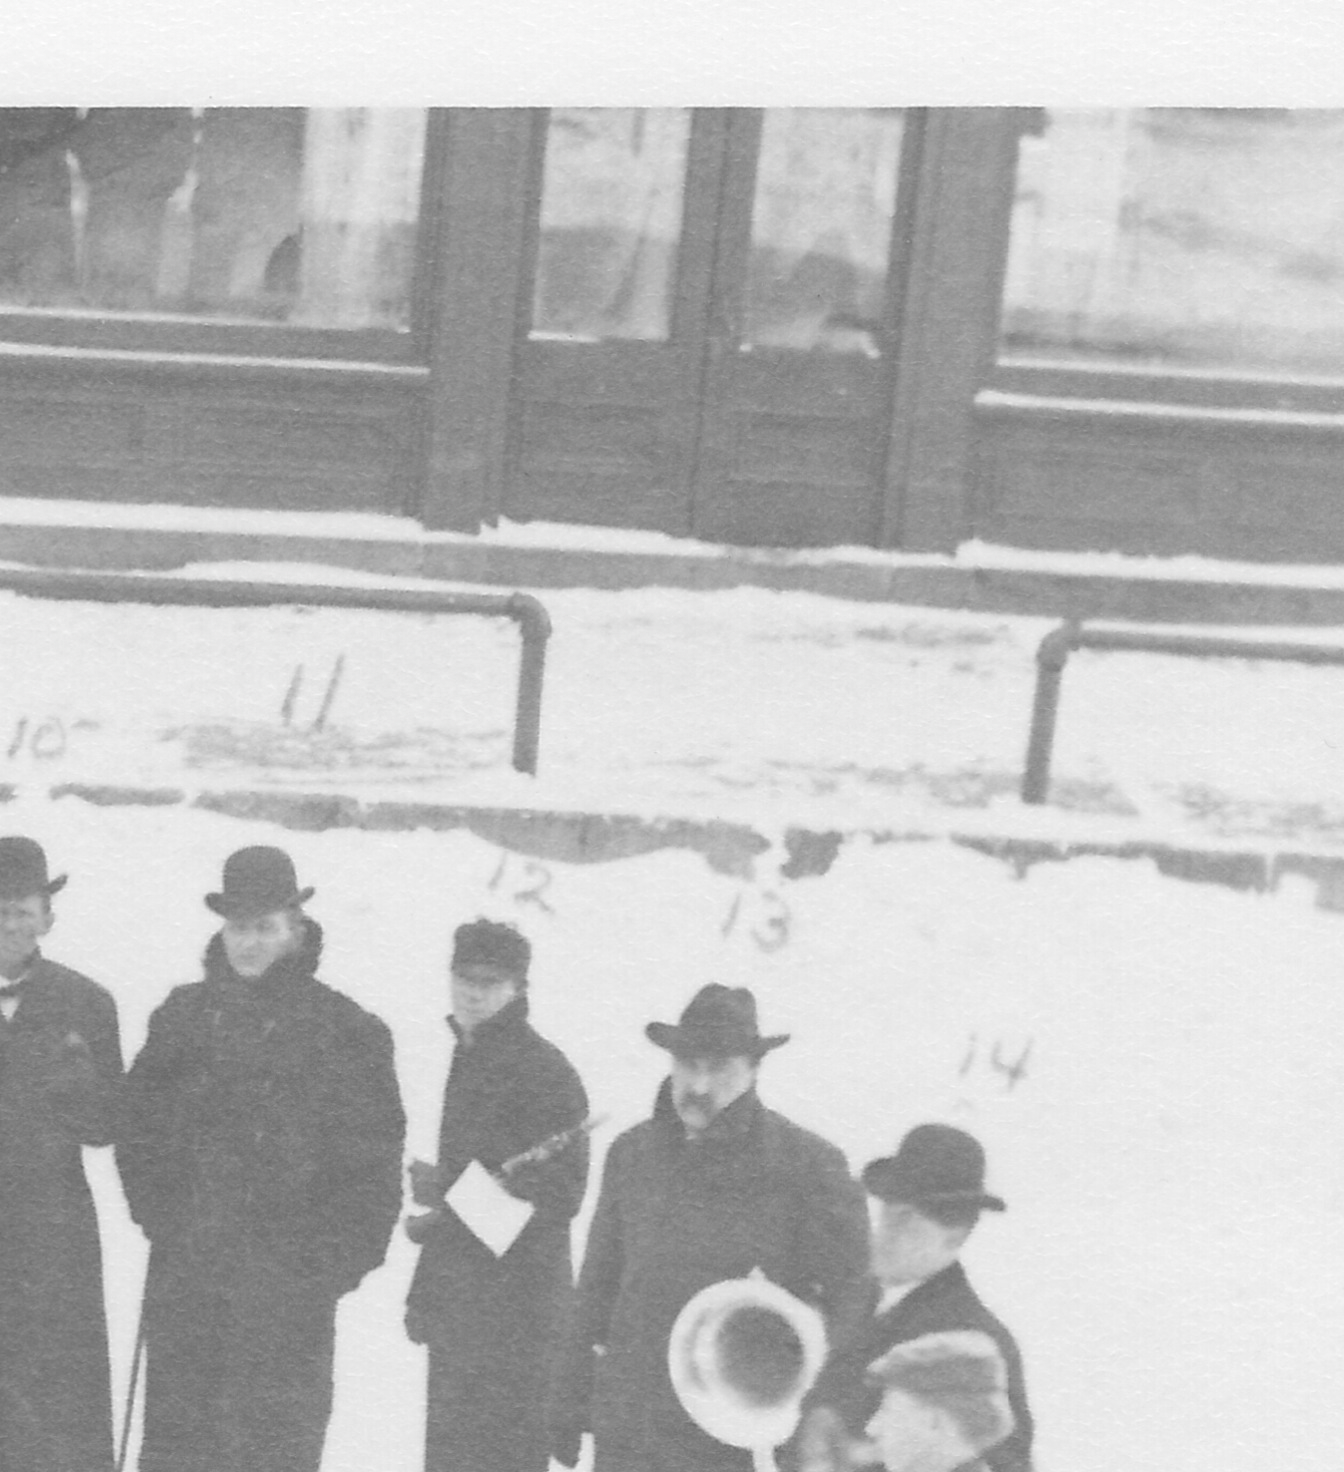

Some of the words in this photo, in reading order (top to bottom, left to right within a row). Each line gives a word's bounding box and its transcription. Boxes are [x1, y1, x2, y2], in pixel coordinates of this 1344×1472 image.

[279, 655, 345, 735] 11
[488, 848, 555, 913] 12
[721, 891, 791, 953] 13
[959, 1034, 1034, 1089] 14
